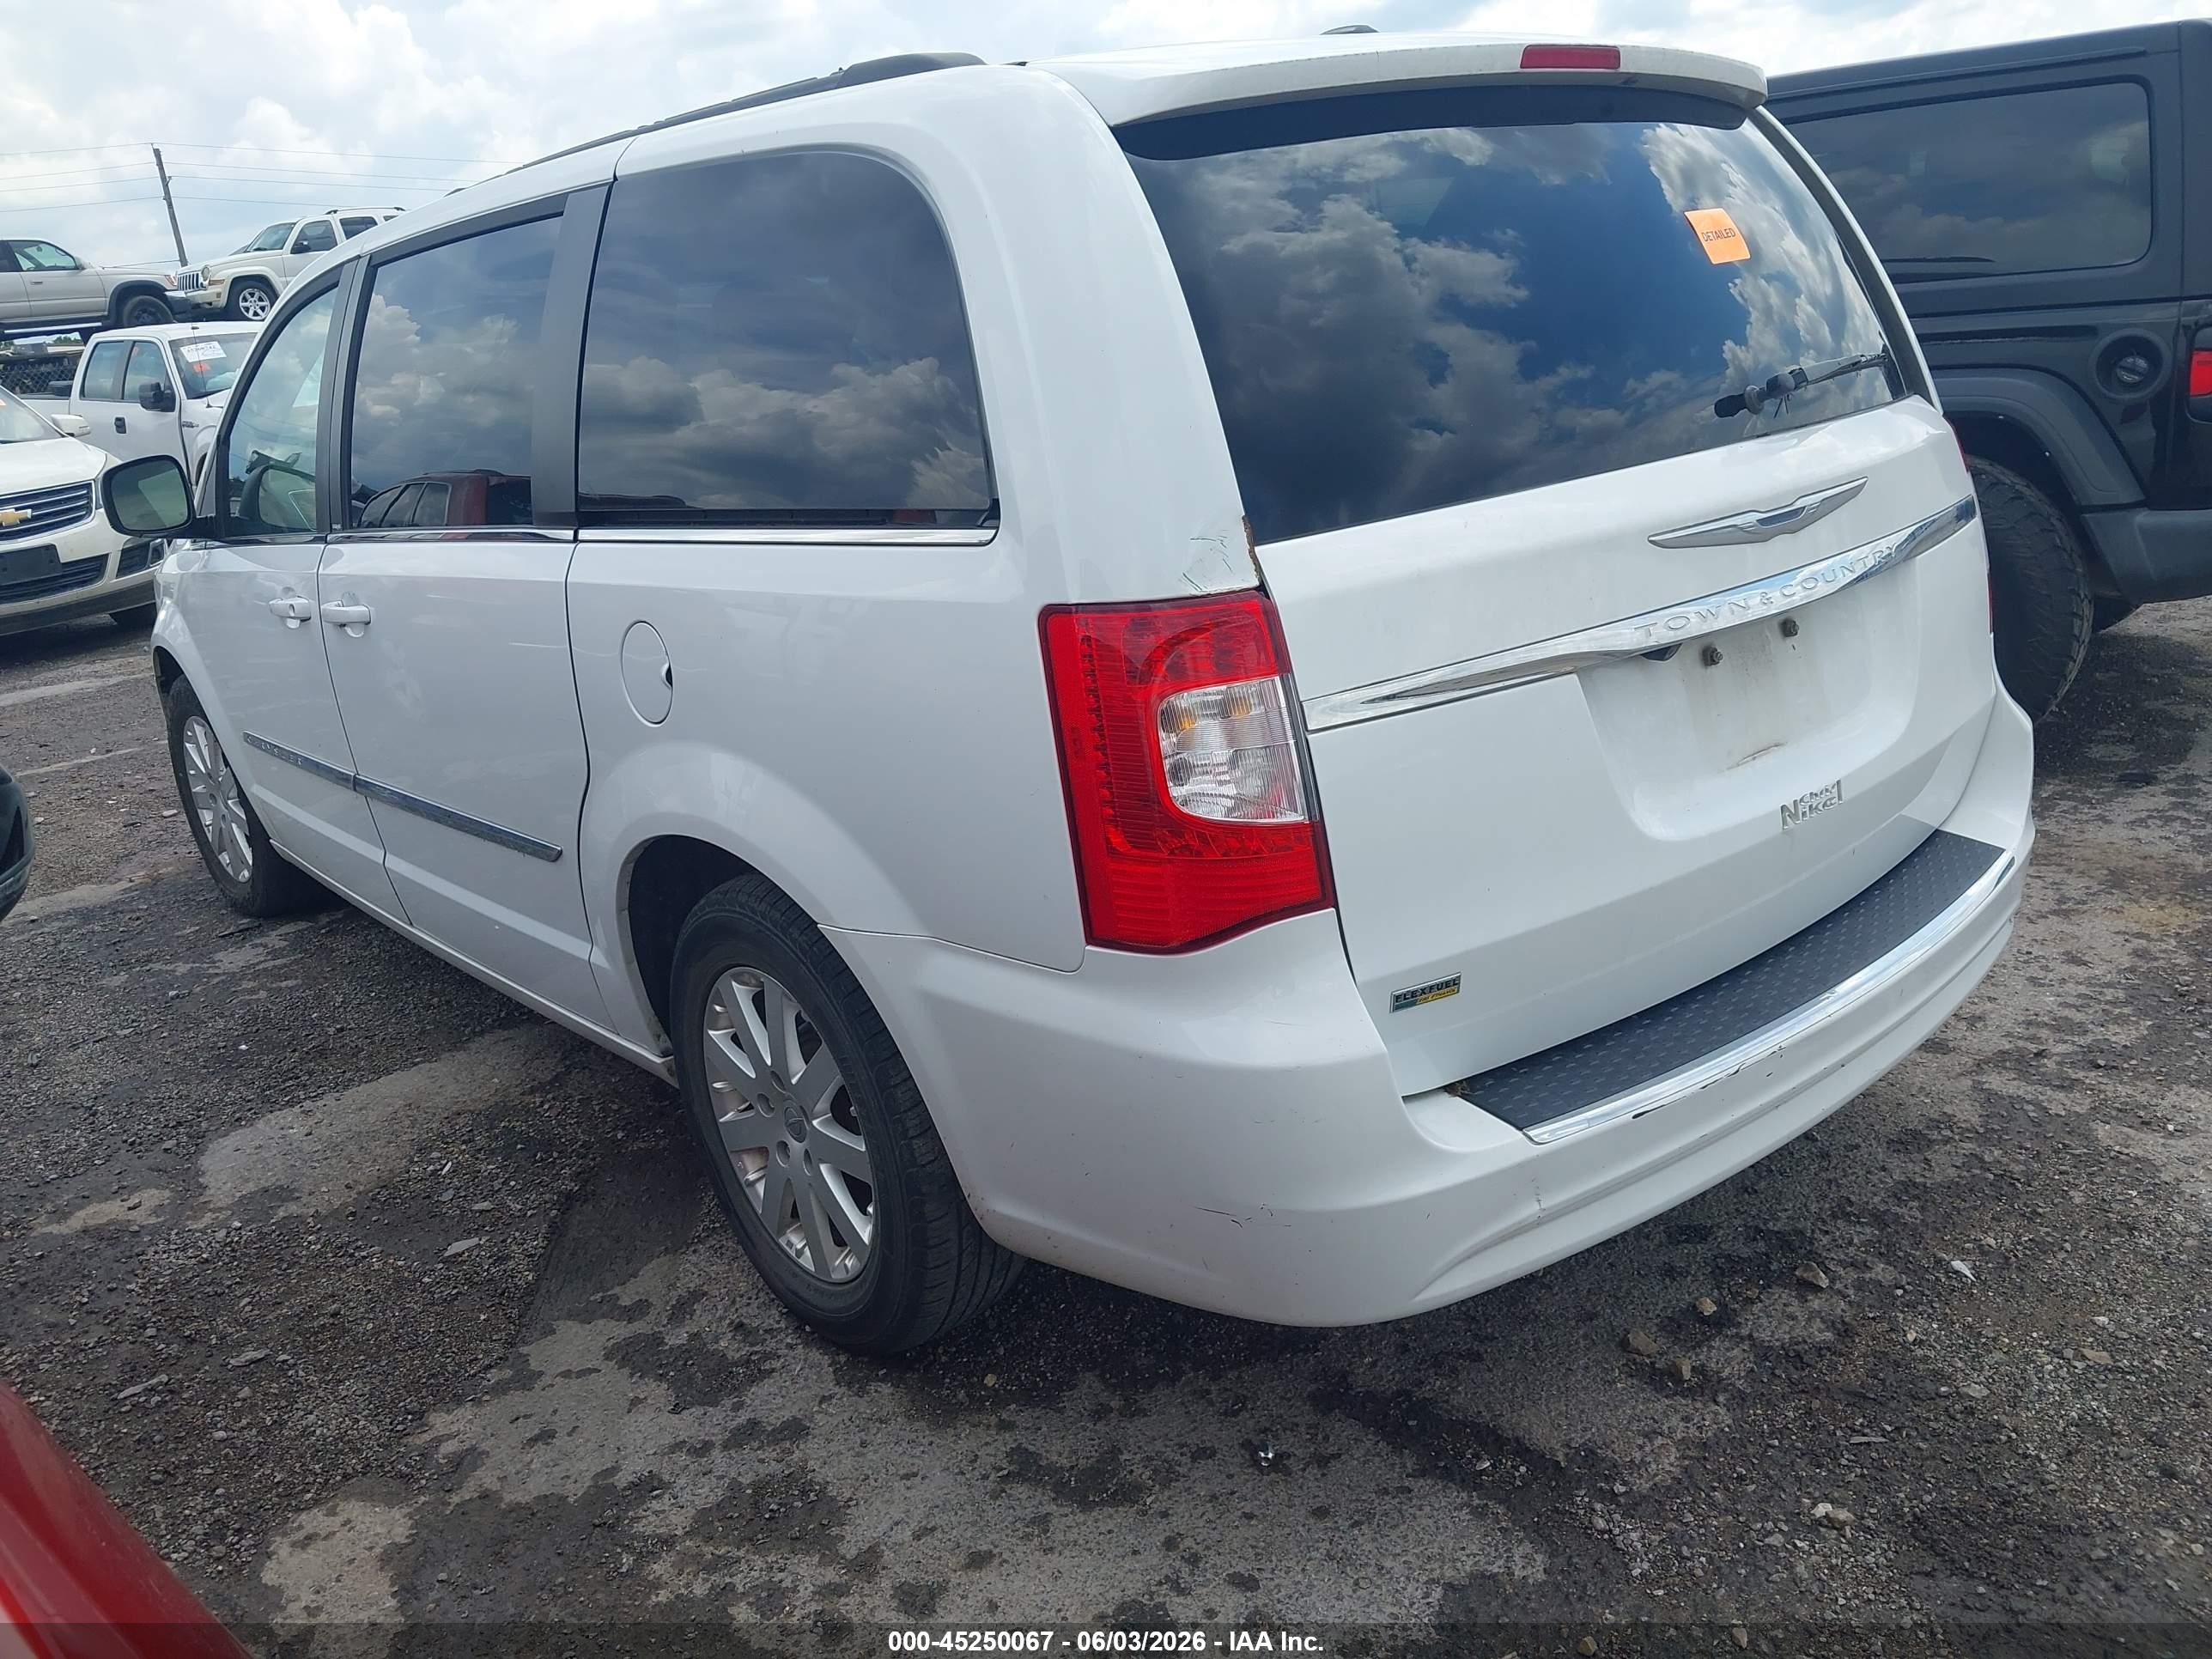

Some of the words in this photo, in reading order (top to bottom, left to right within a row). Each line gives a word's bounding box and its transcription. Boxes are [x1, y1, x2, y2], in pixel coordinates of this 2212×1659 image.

[1701, 228, 1736, 242] DETAILED
[1634, 598, 1749, 637] TOWN
[1759, 591, 1773, 605] &
[1779, 543, 1899, 598] COUNTRY
